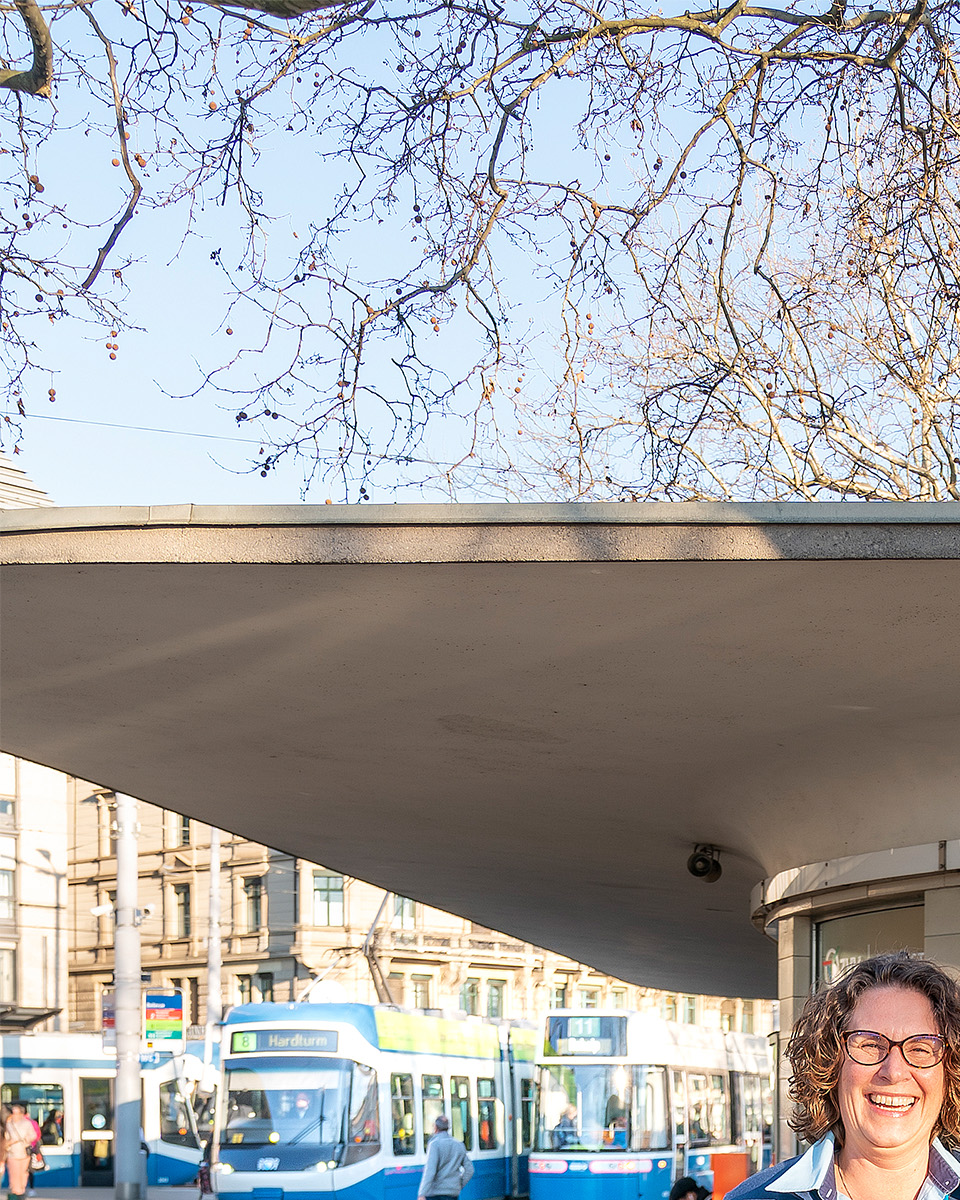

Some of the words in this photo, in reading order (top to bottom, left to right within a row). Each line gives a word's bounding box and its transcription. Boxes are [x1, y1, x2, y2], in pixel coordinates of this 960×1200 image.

[574, 1018, 593, 1035] 11
[242, 1035, 250, 1048] 8
[268, 1034, 328, 1047] Hardturm
